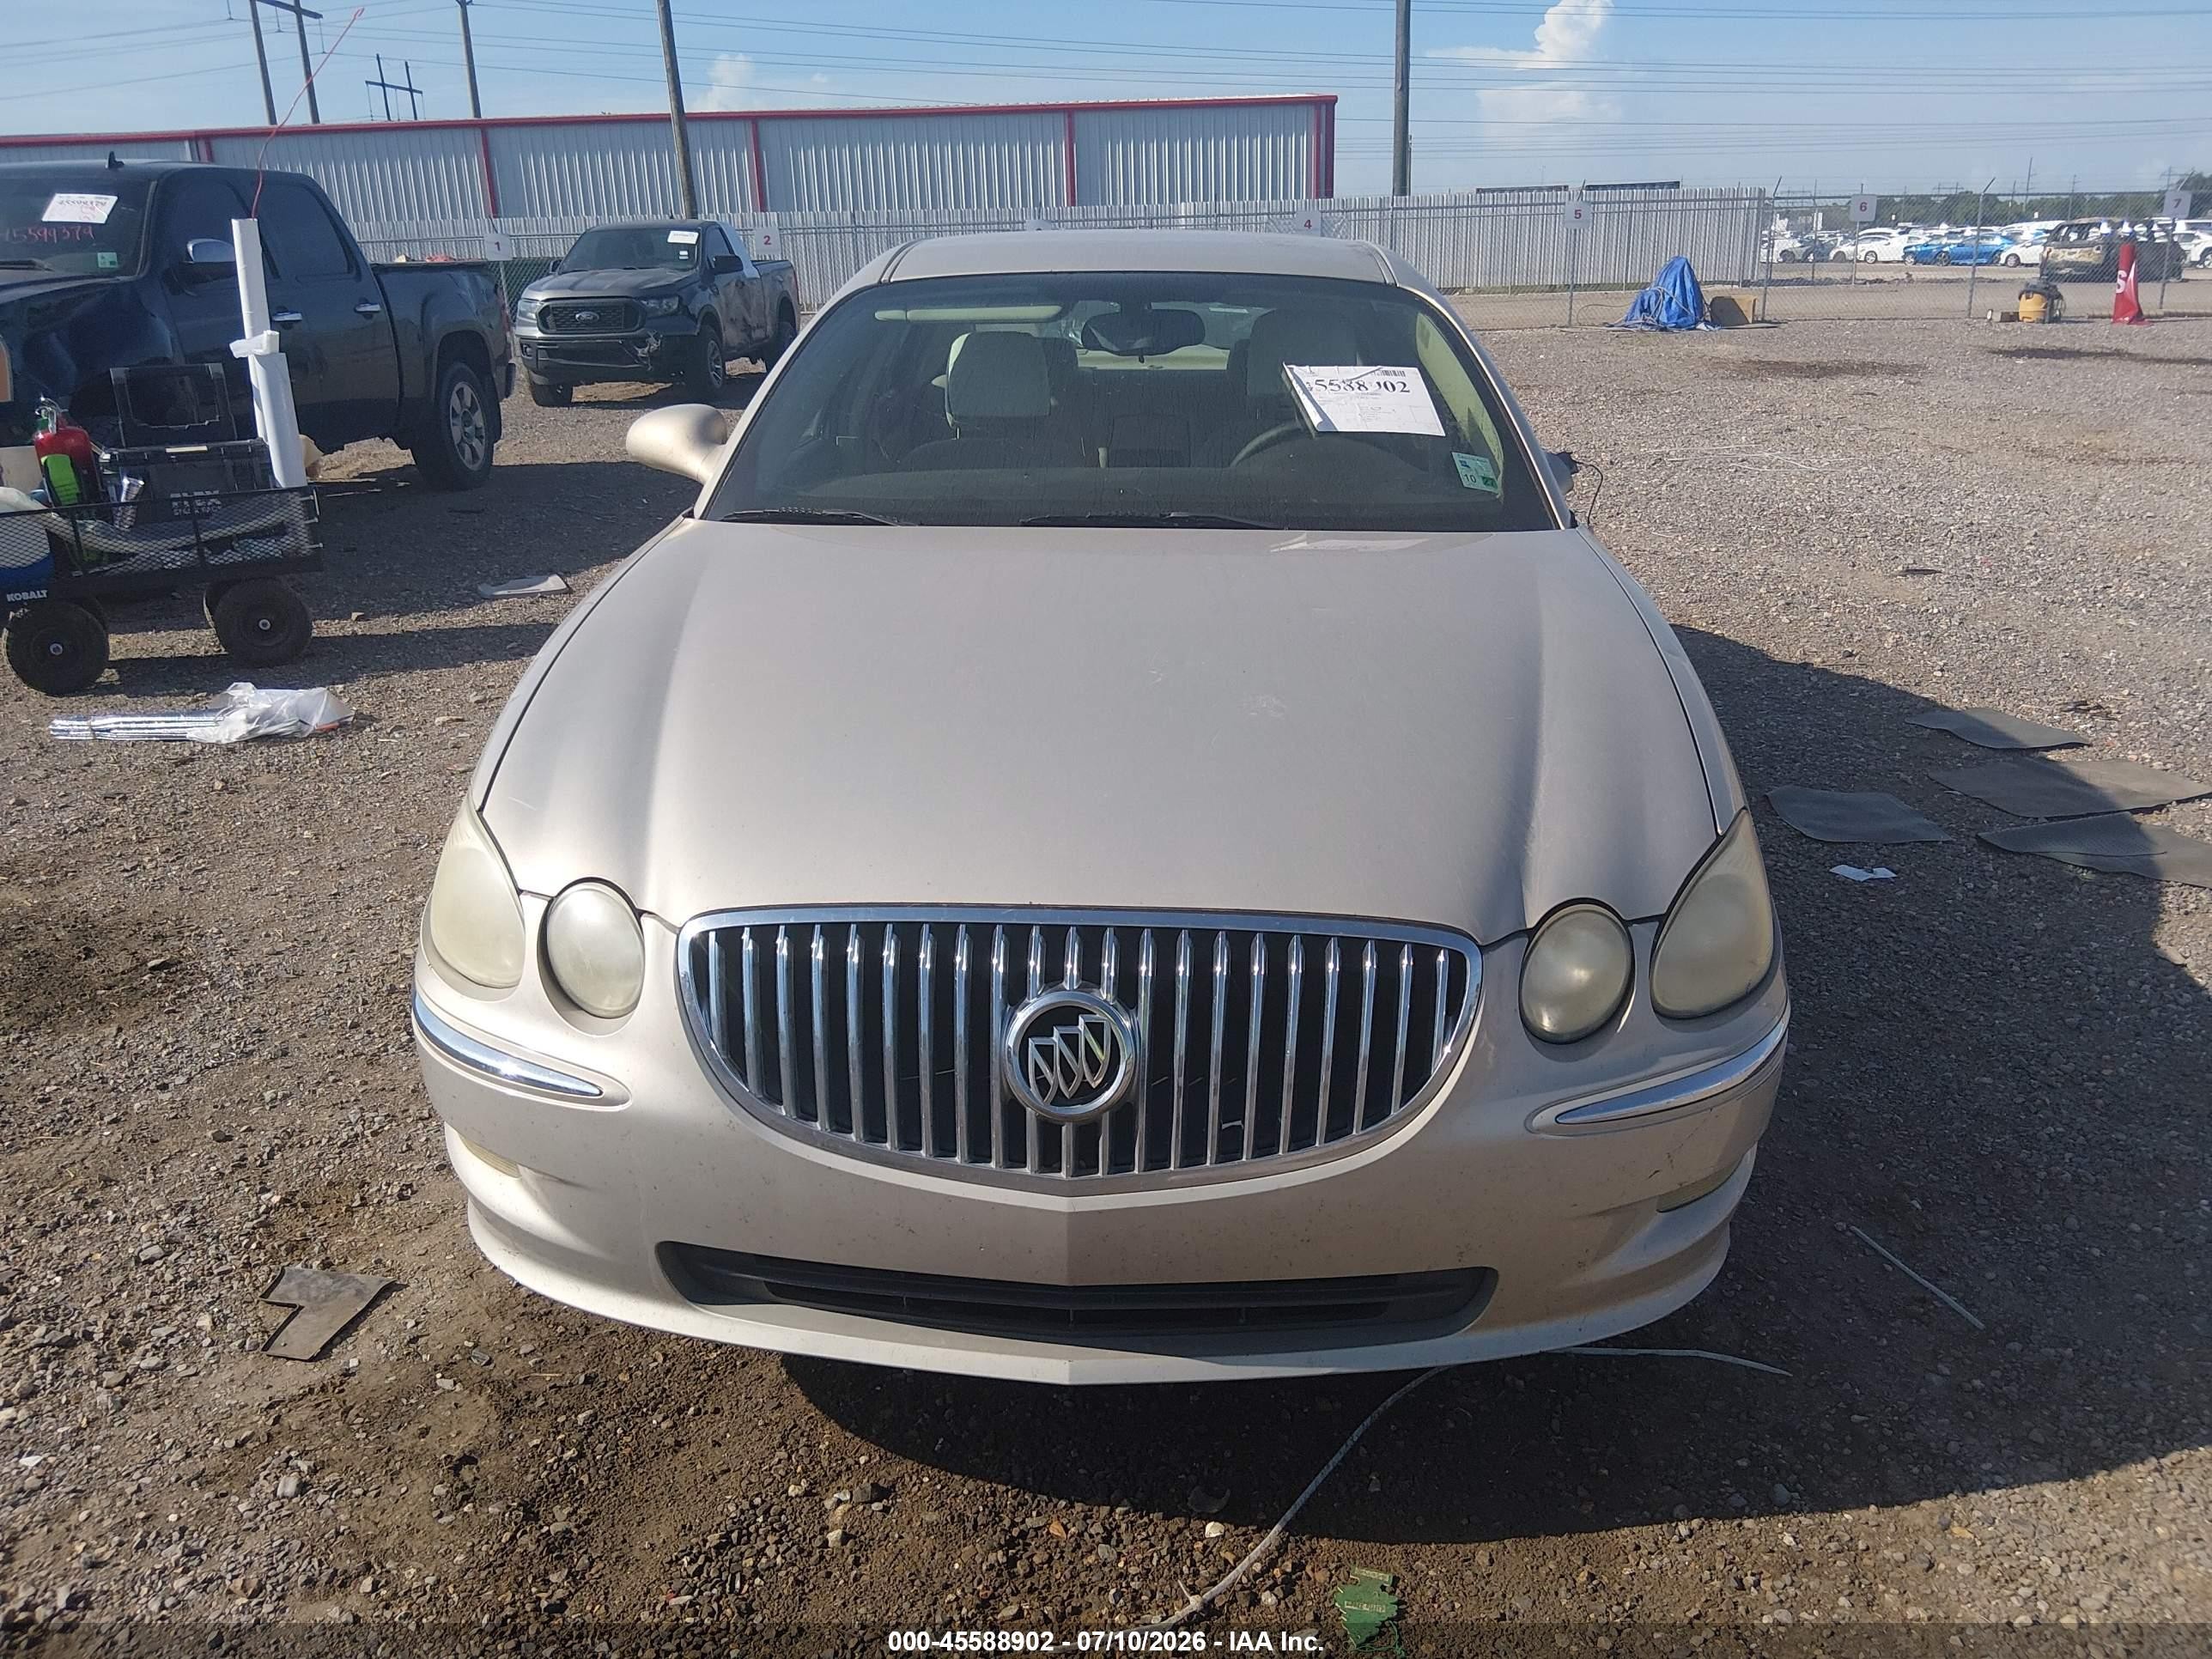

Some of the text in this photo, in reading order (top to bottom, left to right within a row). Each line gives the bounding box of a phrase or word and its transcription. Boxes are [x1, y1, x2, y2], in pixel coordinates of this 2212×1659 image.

[1859, 202, 1868, 212] 6
[2172, 198, 2182, 209] 7
[1574, 209, 1582, 220] 5
[1303, 218, 1312, 230] 4
[494, 240, 501, 252] 1
[763, 234, 772, 246] 2
[2115, 269, 2128, 294] S
[1463, 473, 1477, 483] 10
[6, 589, 49, 603] KOBALT
